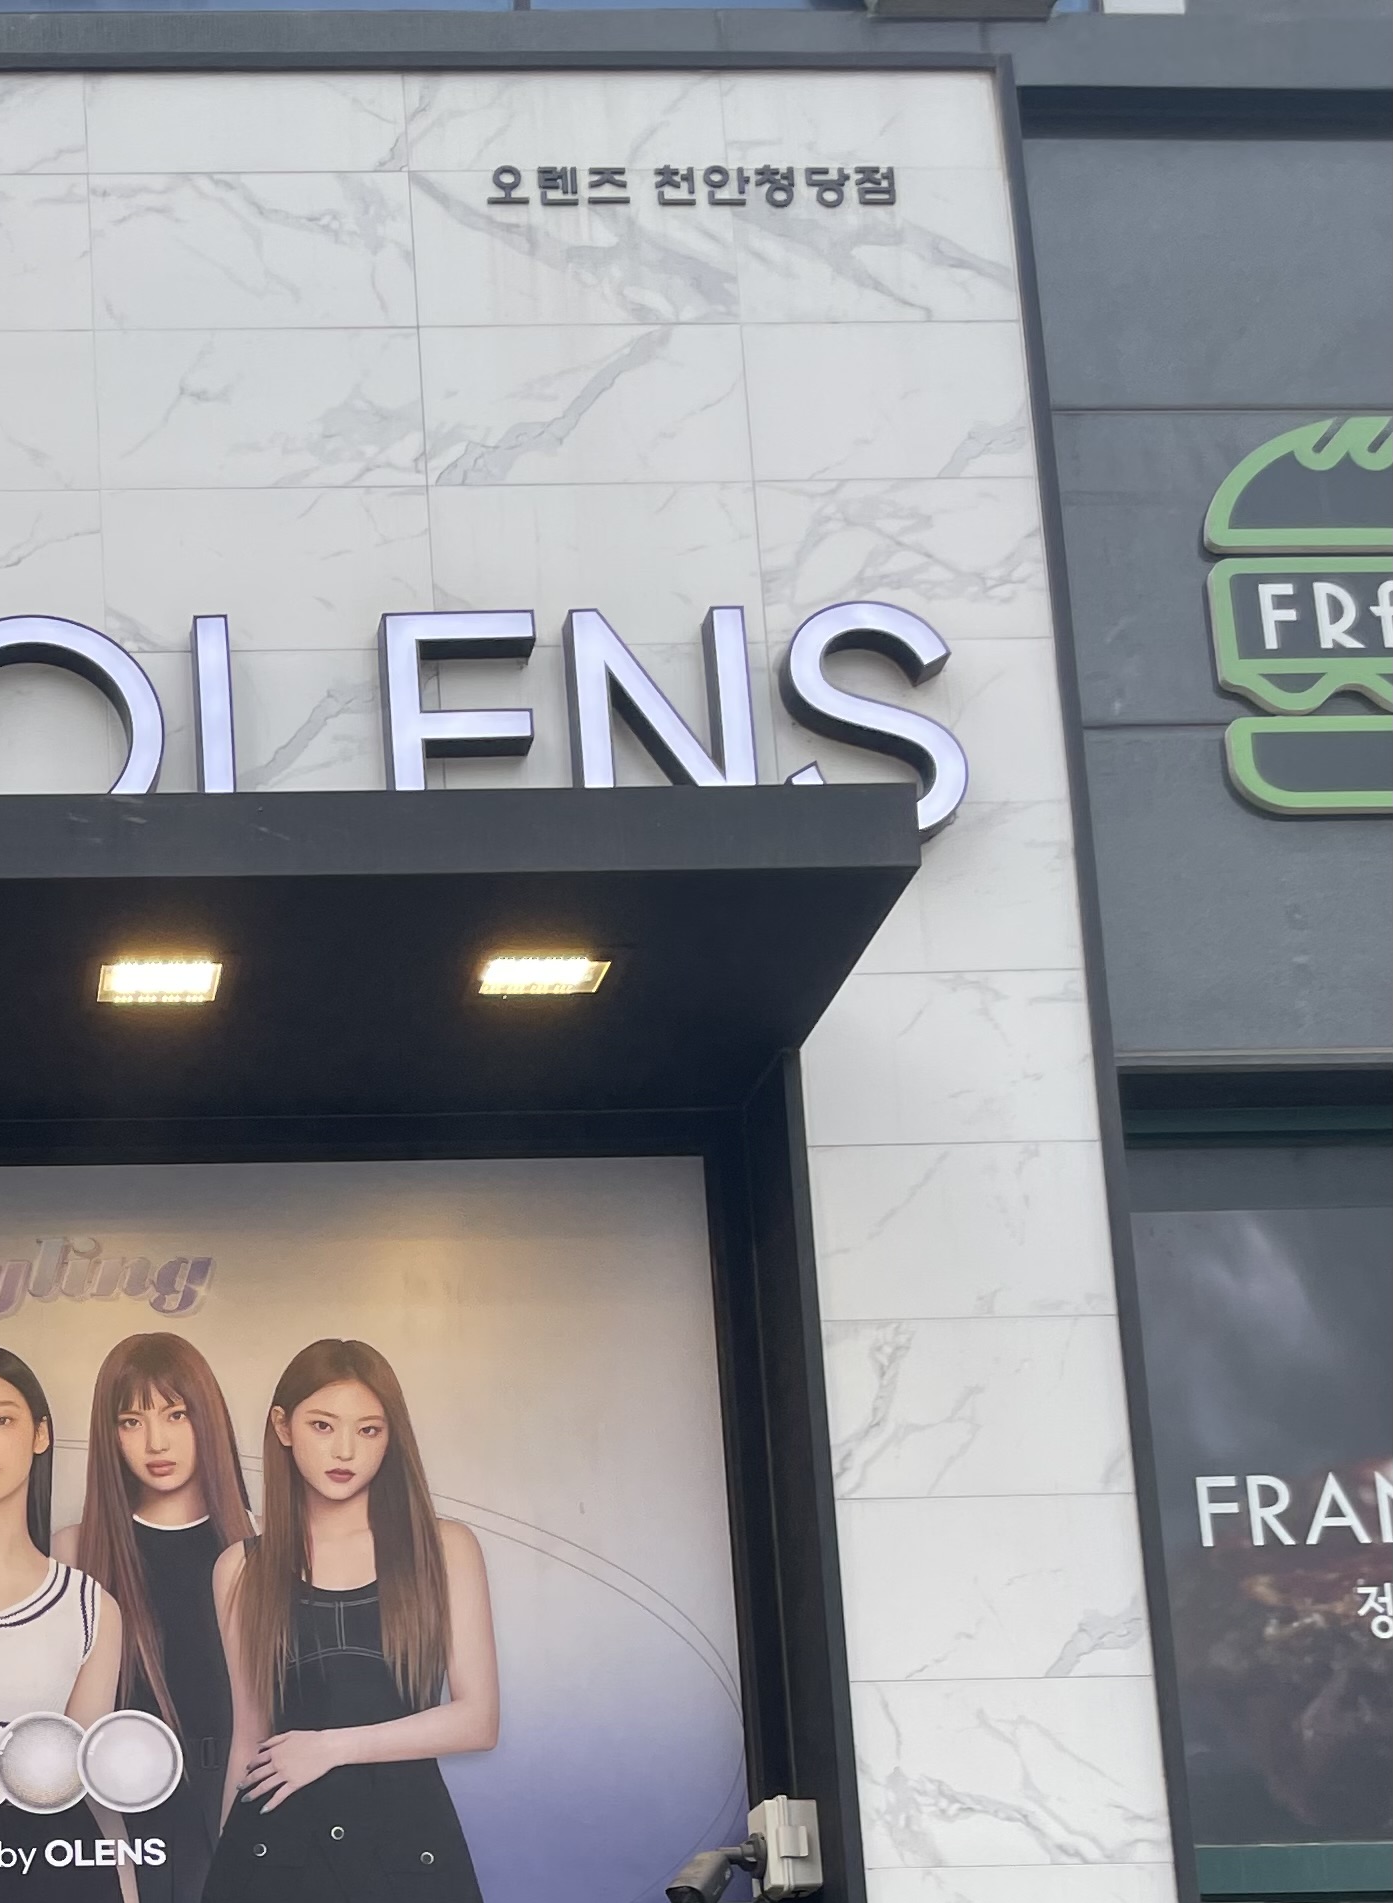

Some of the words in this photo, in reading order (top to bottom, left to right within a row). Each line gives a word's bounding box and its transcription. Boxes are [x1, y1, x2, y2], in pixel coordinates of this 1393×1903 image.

[487, 165, 631, 206] 오렌즈
[654, 164, 897, 207] 천안청당점
[44, 1837, 167, 1868] OLENS
